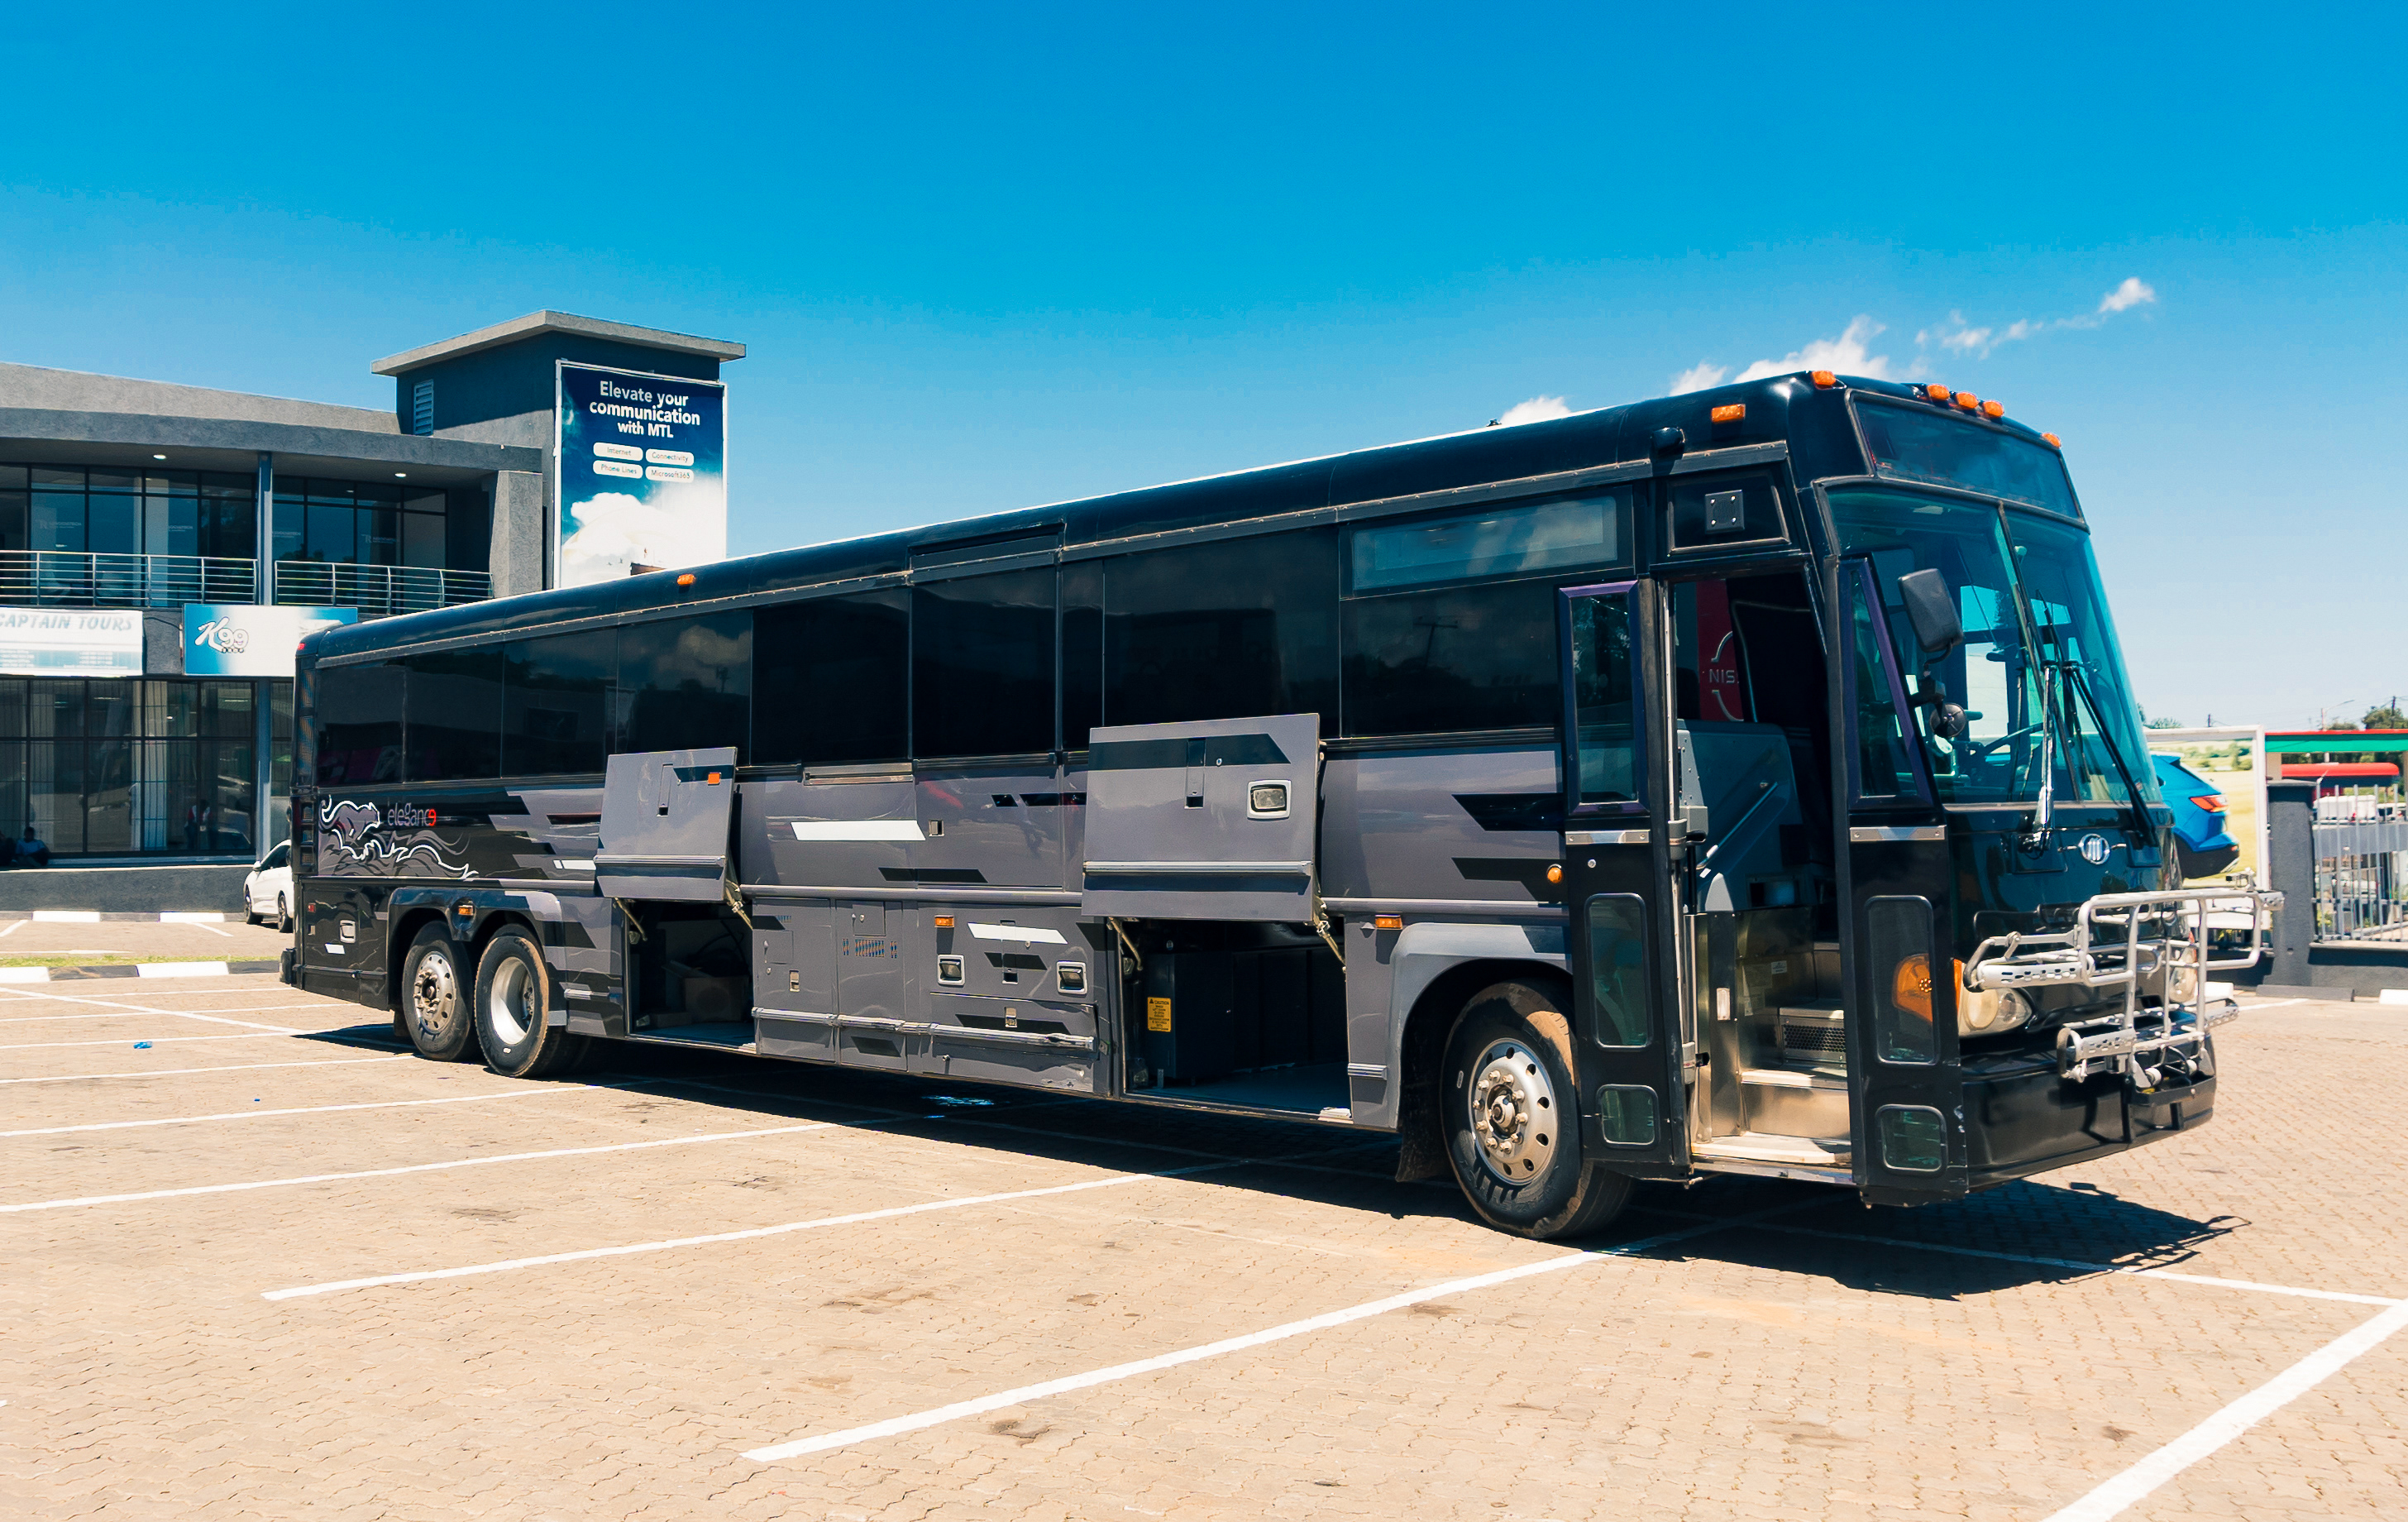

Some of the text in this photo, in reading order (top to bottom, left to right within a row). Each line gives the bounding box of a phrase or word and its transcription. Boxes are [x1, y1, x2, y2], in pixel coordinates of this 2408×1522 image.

[600, 380, 689, 408] Elevate your
[590, 400, 700, 426] communication
[617, 421, 674, 438] with MTL
[607, 447, 632, 456] Internet
[652, 452, 689, 463] Connectivity
[600, 463, 637, 474] Phone Lines
[78, 615, 135, 631] TOURS
[1709, 668, 1739, 683] NIS
